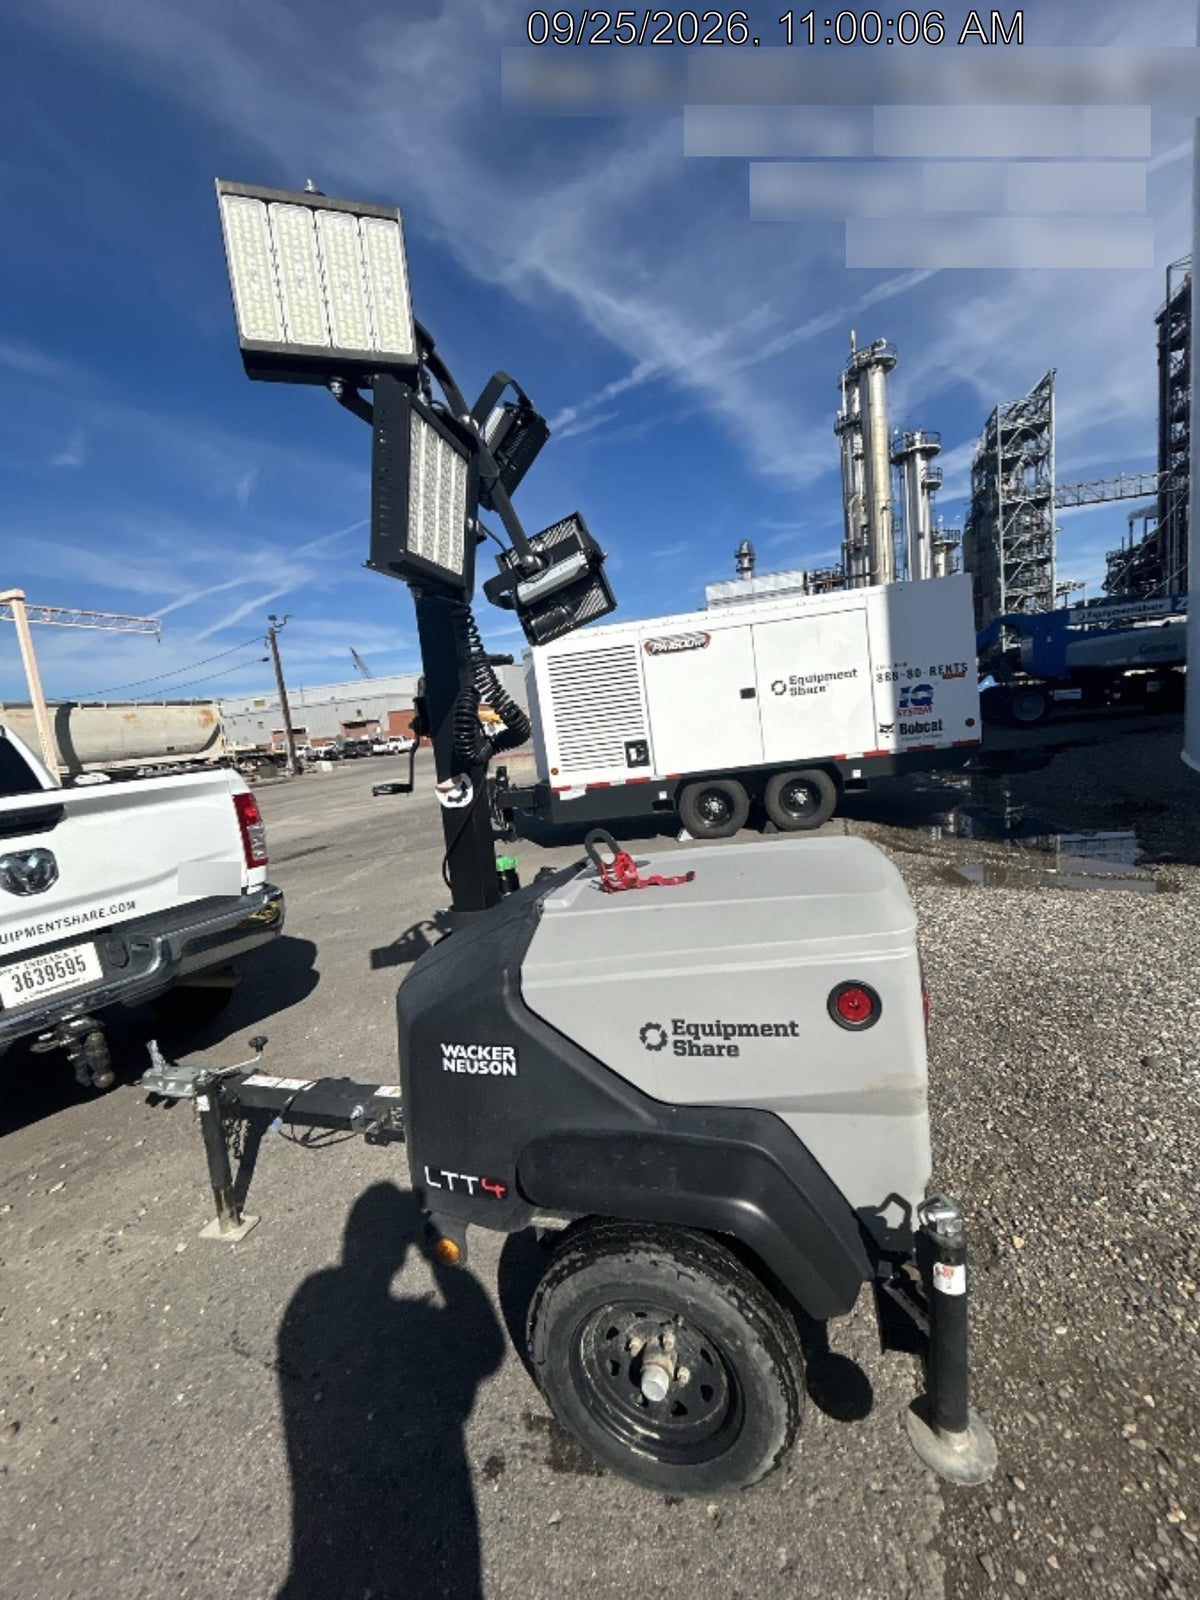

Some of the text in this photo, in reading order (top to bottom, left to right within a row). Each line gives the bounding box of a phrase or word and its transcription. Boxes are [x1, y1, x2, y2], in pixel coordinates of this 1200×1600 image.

[789, 668, 858, 686] Equipment
[789, 686, 827, 697] Share
[899, 718, 943, 735] Bobcat
[11, 954, 86, 992] 3639595
[672, 1019, 800, 1038] Equipment
[440, 1043, 516, 1061] WACKER
[673, 1038, 740, 1057] Share
[442, 1057, 517, 1076] NEUSON
[424, 1165, 506, 1200] LTT4
